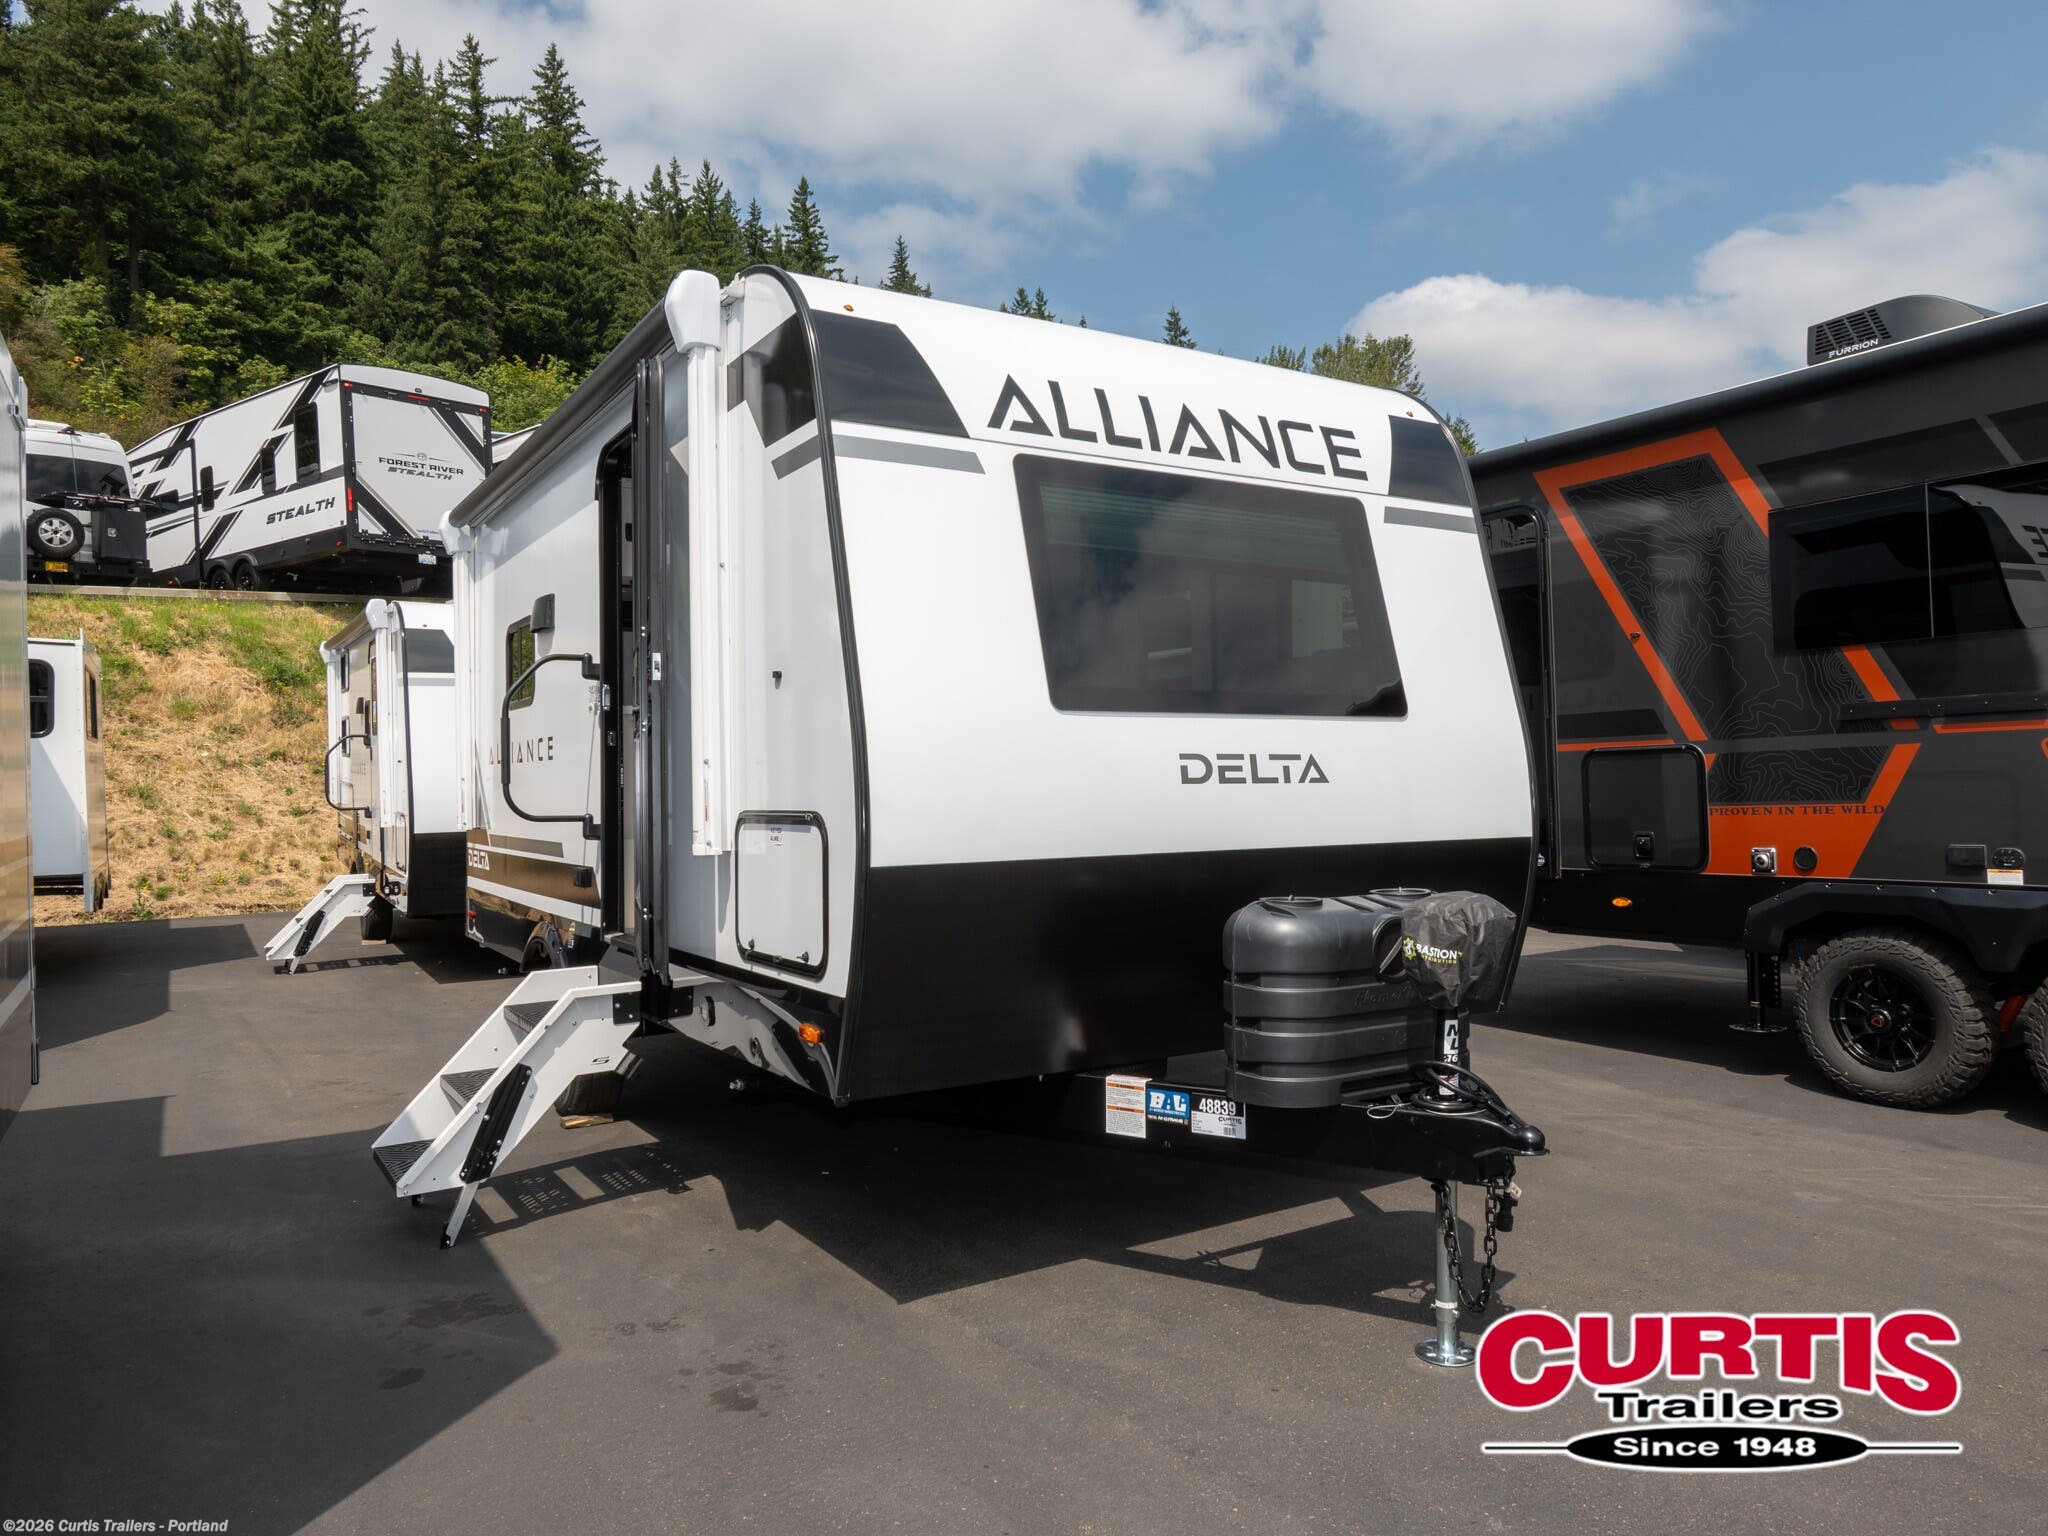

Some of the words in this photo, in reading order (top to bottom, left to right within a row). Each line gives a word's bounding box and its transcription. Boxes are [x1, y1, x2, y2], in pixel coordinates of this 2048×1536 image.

[1828, 338, 1879, 359] FURRION
[987, 374, 1369, 482] ALLIANCE
[378, 457, 426, 470] FOREST
[429, 464, 464, 475] RIVER
[387, 466, 453, 480] STEALTH
[266, 496, 336, 525] STEALTH
[489, 735, 553, 765] ALIANCE
[1178, 752, 1330, 785] DELTA
[1709, 807, 1773, 817] PROVEN
[1778, 806, 1796, 816] IN
[1801, 806, 1836, 816] THE
[1841, 804, 1887, 815] WILD
[468, 848, 490, 871] DELTA
[1416, 943, 1458, 960] BASTION
[1150, 1091, 1187, 1112] BAL
[1199, 1098, 1236, 1115] 48839
